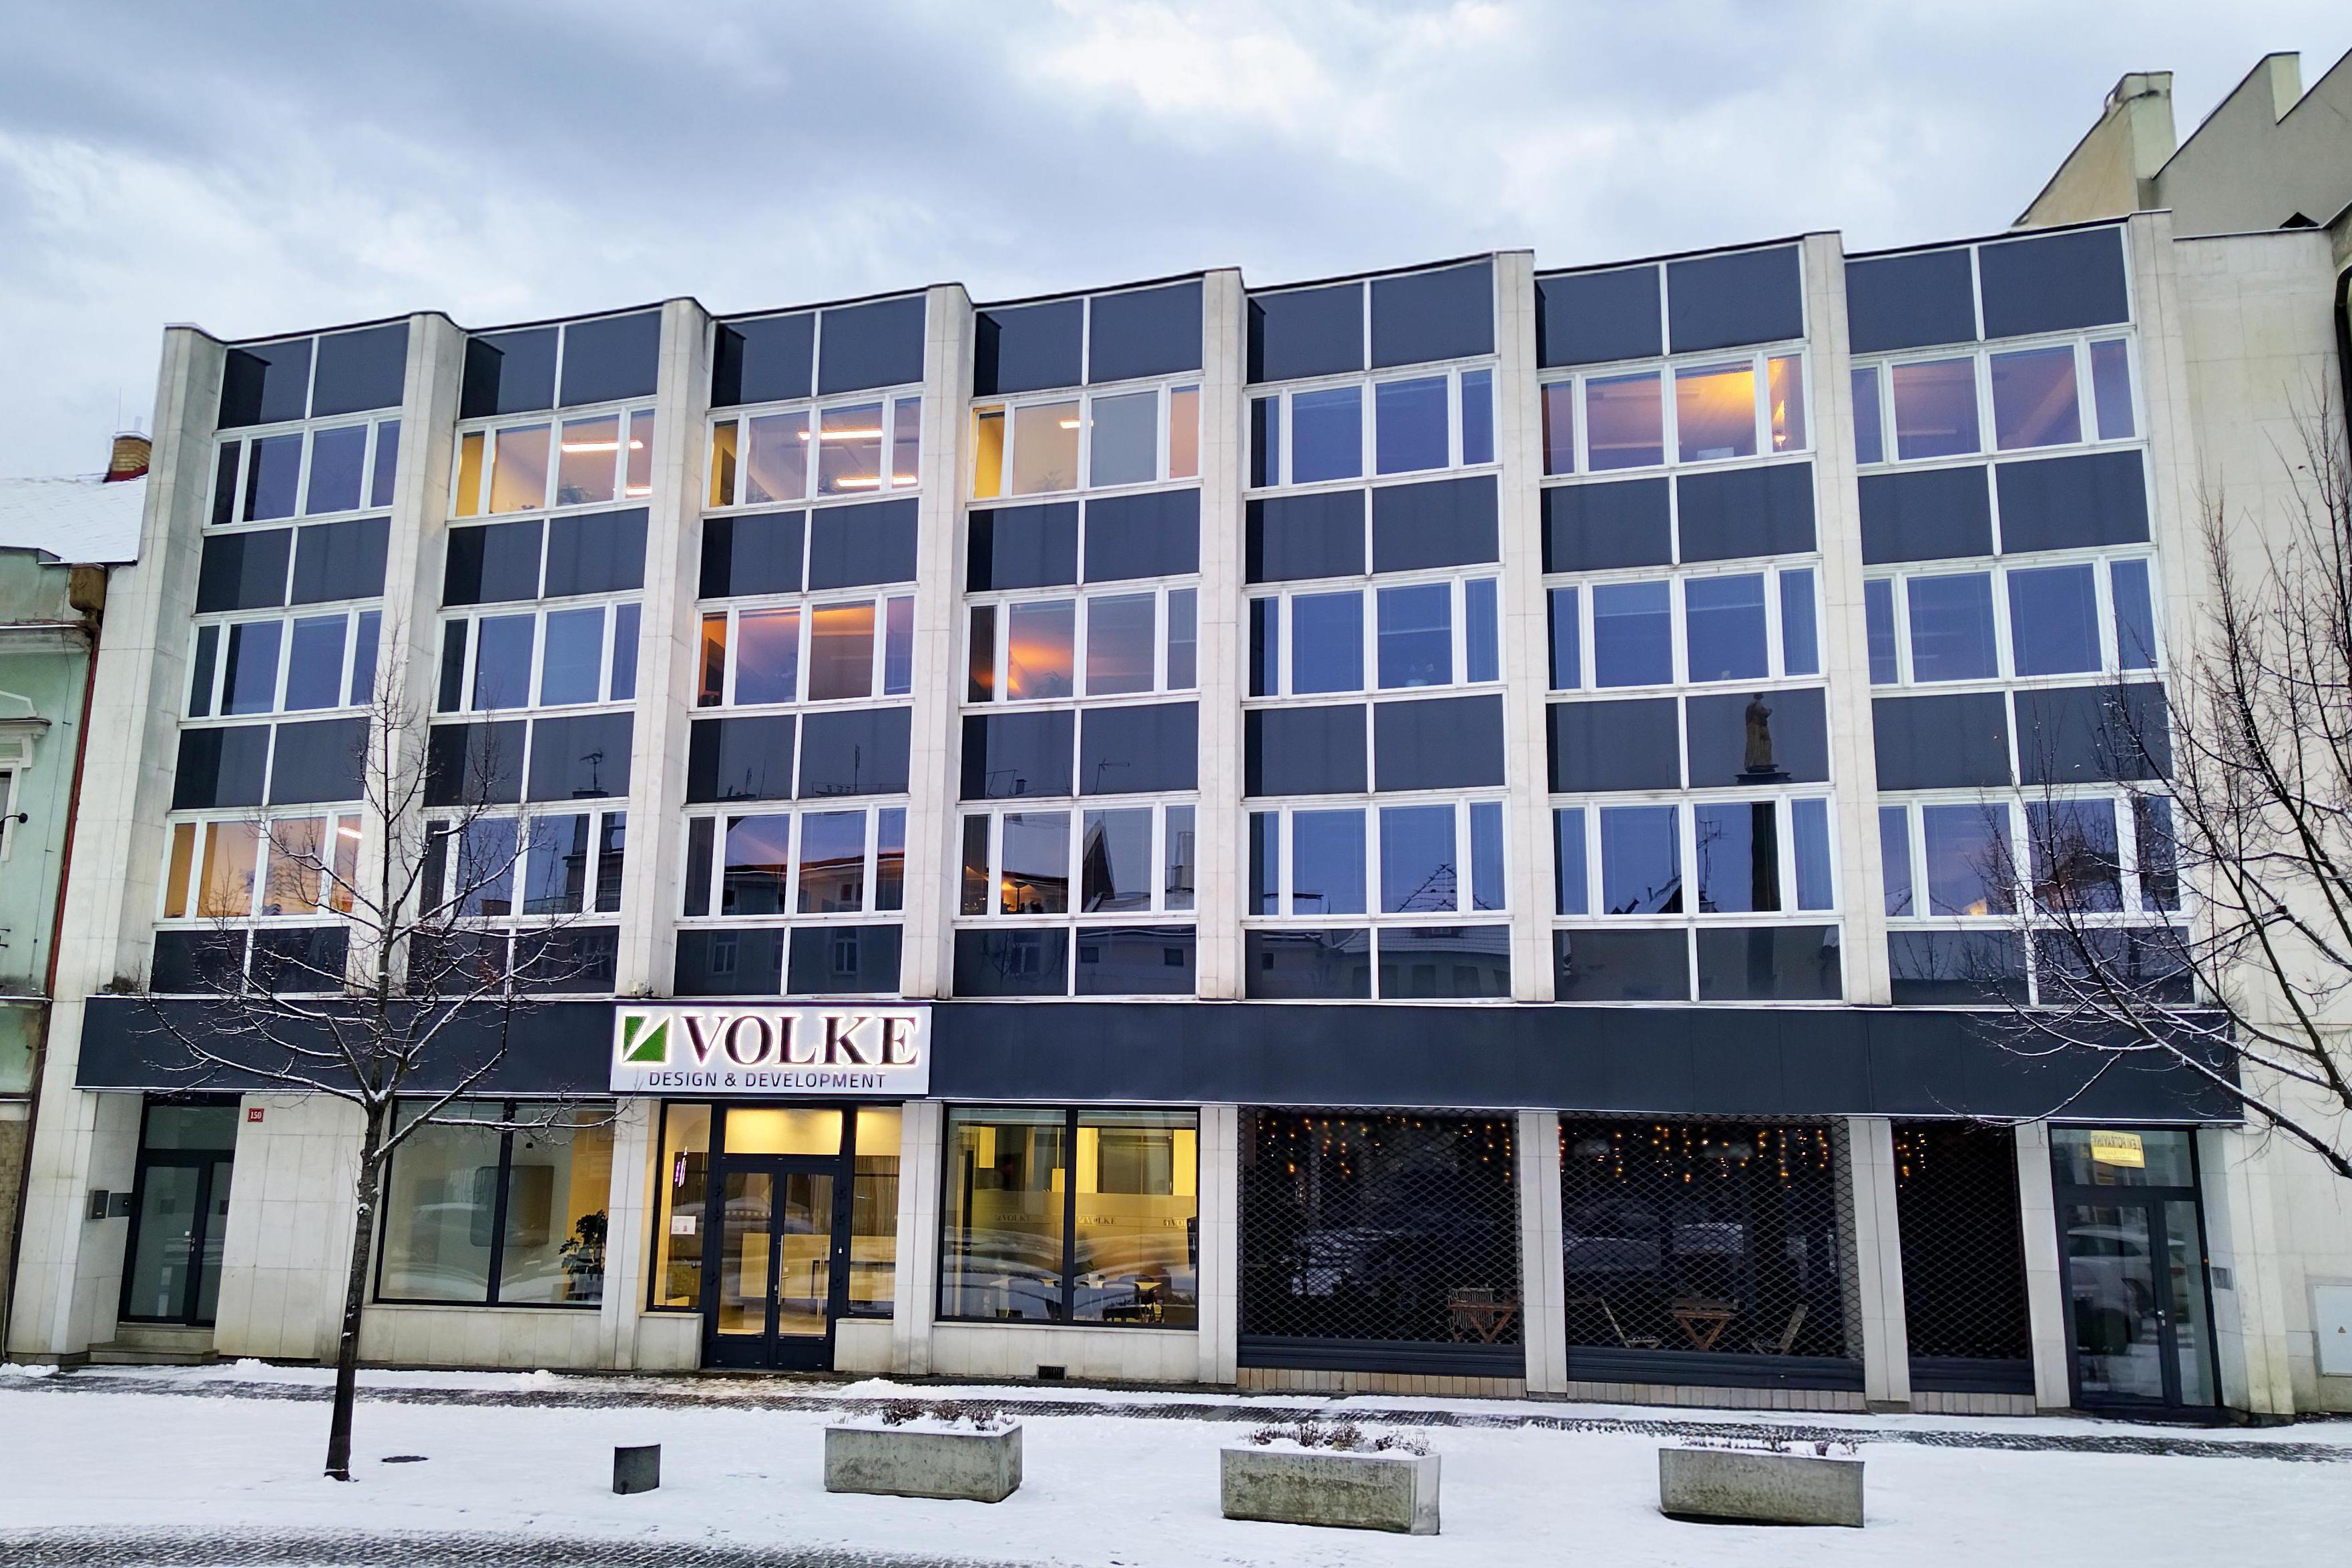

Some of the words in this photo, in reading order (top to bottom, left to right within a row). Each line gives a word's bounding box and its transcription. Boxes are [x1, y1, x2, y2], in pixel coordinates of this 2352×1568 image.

[681, 1015, 917, 1064] VOLKE
[649, 1071, 716, 1086] DESIGN
[725, 1072, 737, 1087] &
[746, 1073, 887, 1088] DEVELOPMENT
[250, 1111, 262, 1119] 150
[1001, 1214, 1031, 1222] VOLKE
[1086, 1216, 1116, 1224] VOLKE
